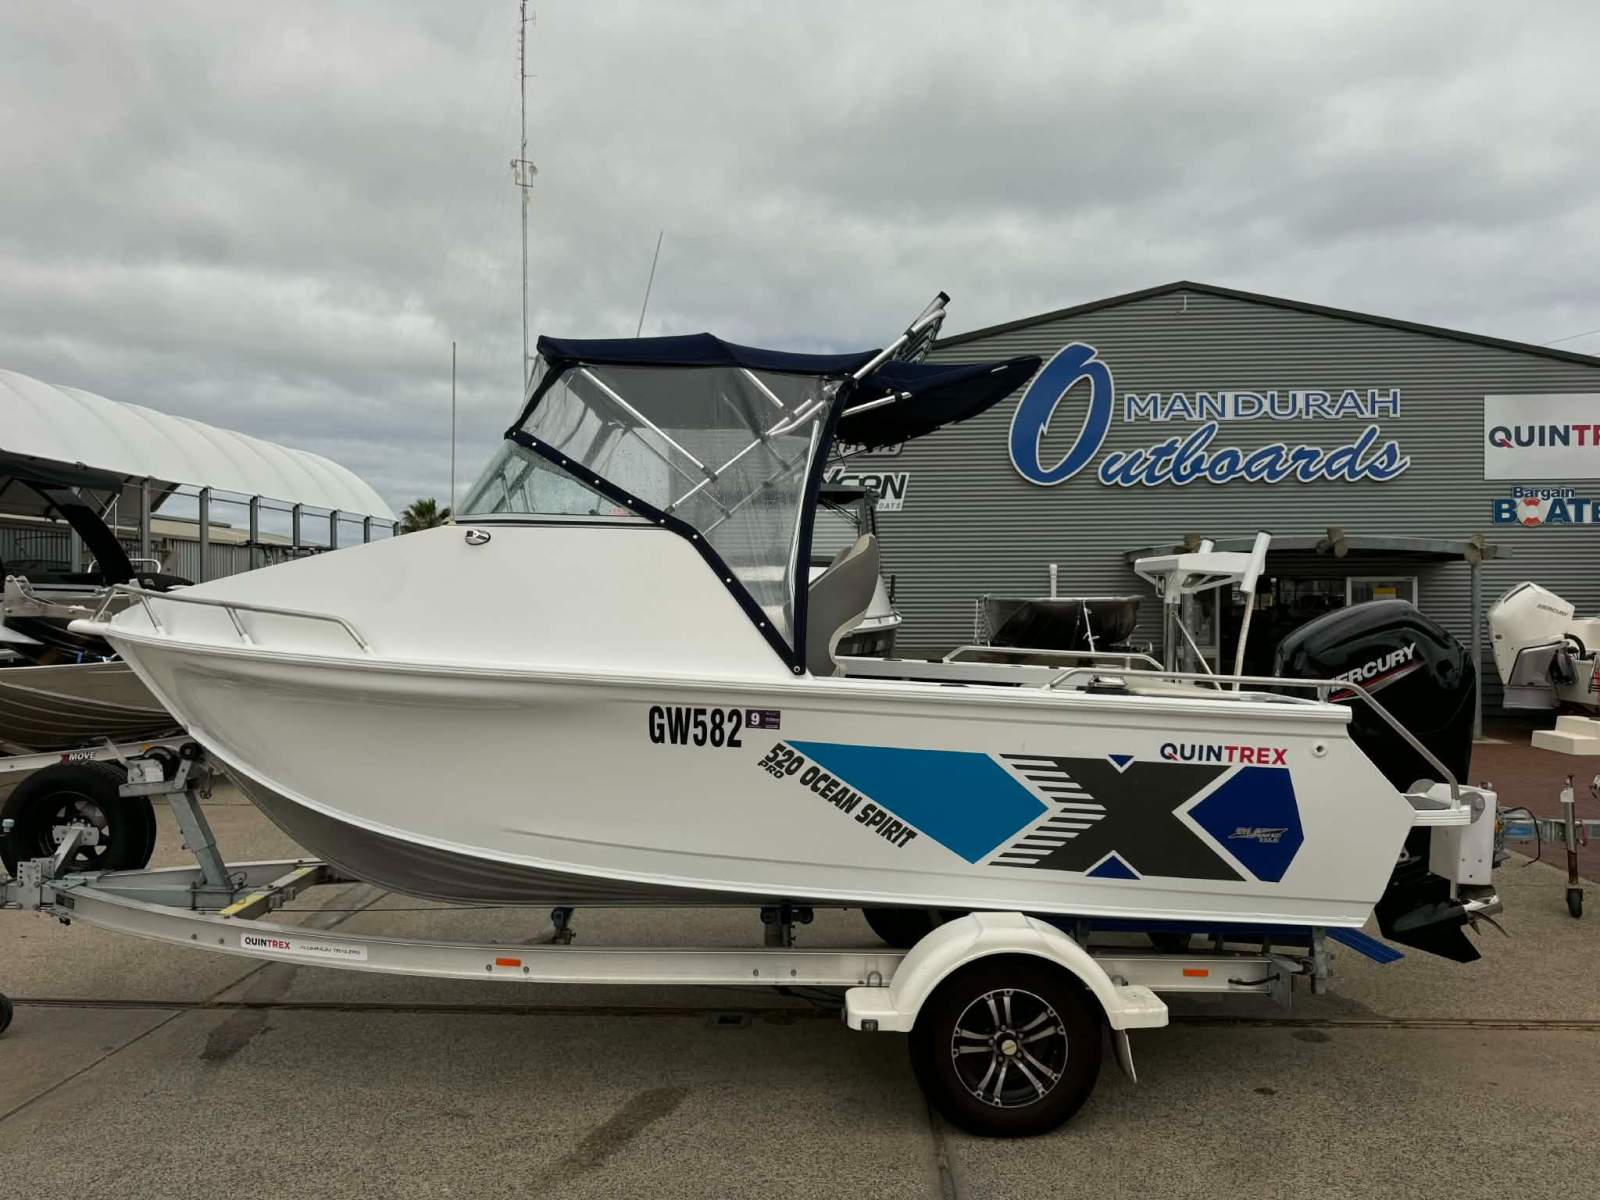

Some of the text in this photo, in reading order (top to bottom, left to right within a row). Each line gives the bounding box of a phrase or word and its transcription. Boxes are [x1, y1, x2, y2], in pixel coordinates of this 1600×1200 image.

[1008, 342, 1411, 486] Outboards
[1124, 389, 1401, 422] MANDURAH
[1512, 485, 1576, 500] Bargain
[1493, 498, 1600, 527] BOAT
[648, 705, 743, 748] GW582
[750, 712, 760, 726] 9
[1160, 743, 1288, 766] QUINTREX
[757, 759, 785, 779] PRO
[764, 743, 918, 848] 520 OCEAN SPIRIT
[244, 937, 290, 950] QUINTREX
